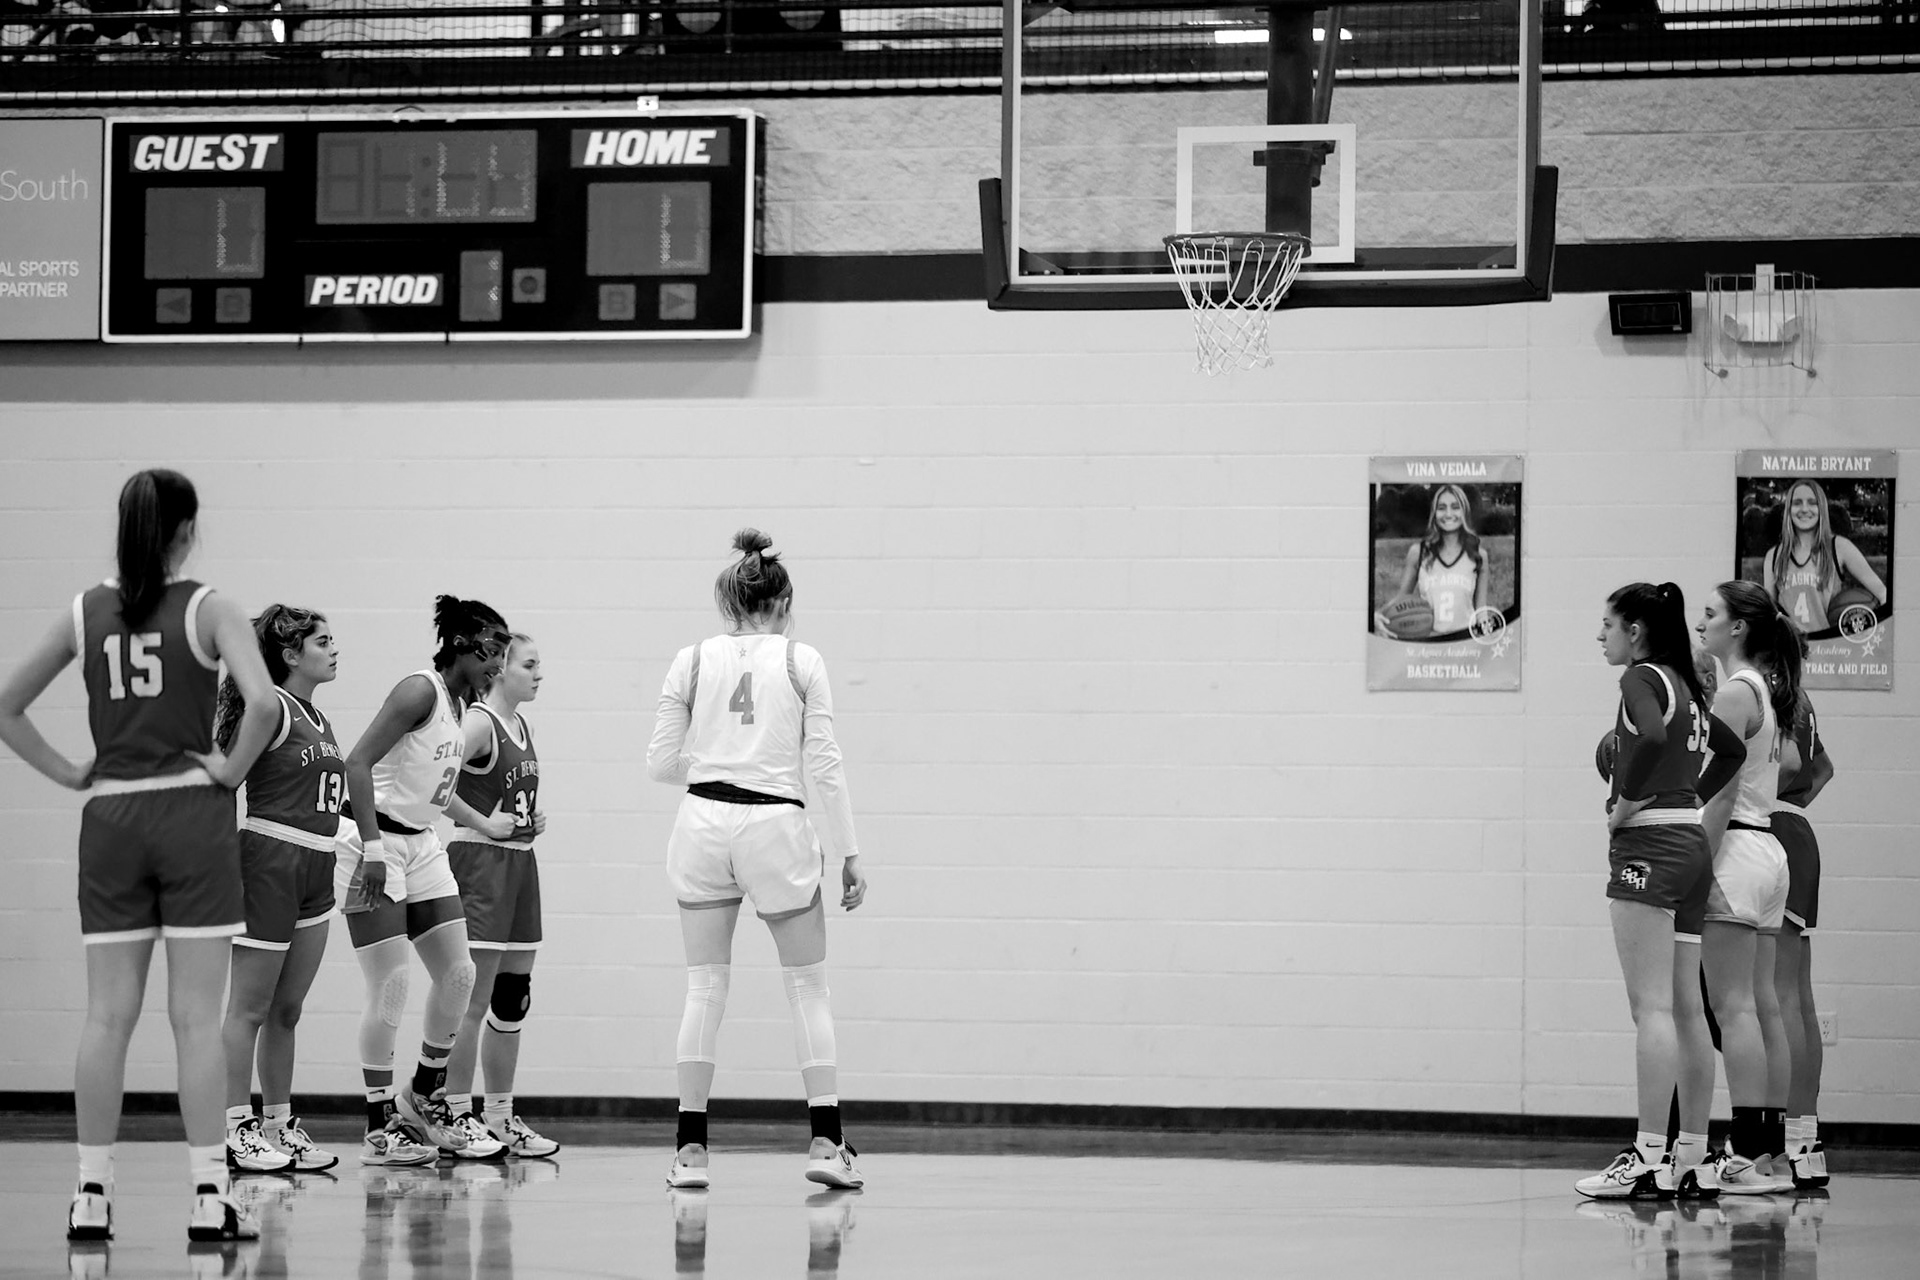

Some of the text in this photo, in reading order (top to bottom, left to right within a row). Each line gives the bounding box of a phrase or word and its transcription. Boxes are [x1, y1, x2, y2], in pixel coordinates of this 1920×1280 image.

[134, 134, 279, 171] GUEST
[583, 129, 717, 166] HOME
[0, 168, 89, 202] South
[19, 260, 80, 278] SPORTS
[0, 282, 69, 298] PARTNER
[310, 274, 439, 306] PERIOD
[1407, 462, 1487, 477] VINA VEDALA
[1762, 456, 1871, 472] NATALIE BRYANT
[1439, 592, 1454, 623] 2
[1793, 592, 1810, 623] 4
[103, 631, 163, 700] 15
[1407, 664, 1481, 679] BASKETBALL
[1805, 663, 1888, 676] TRACK AND FIELD
[729, 671, 754, 725] 4
[300, 743, 321, 768] ST.
[316, 770, 342, 814] 13
[505, 766, 520, 790] ST.
[1620, 867, 1647, 891] SBA
